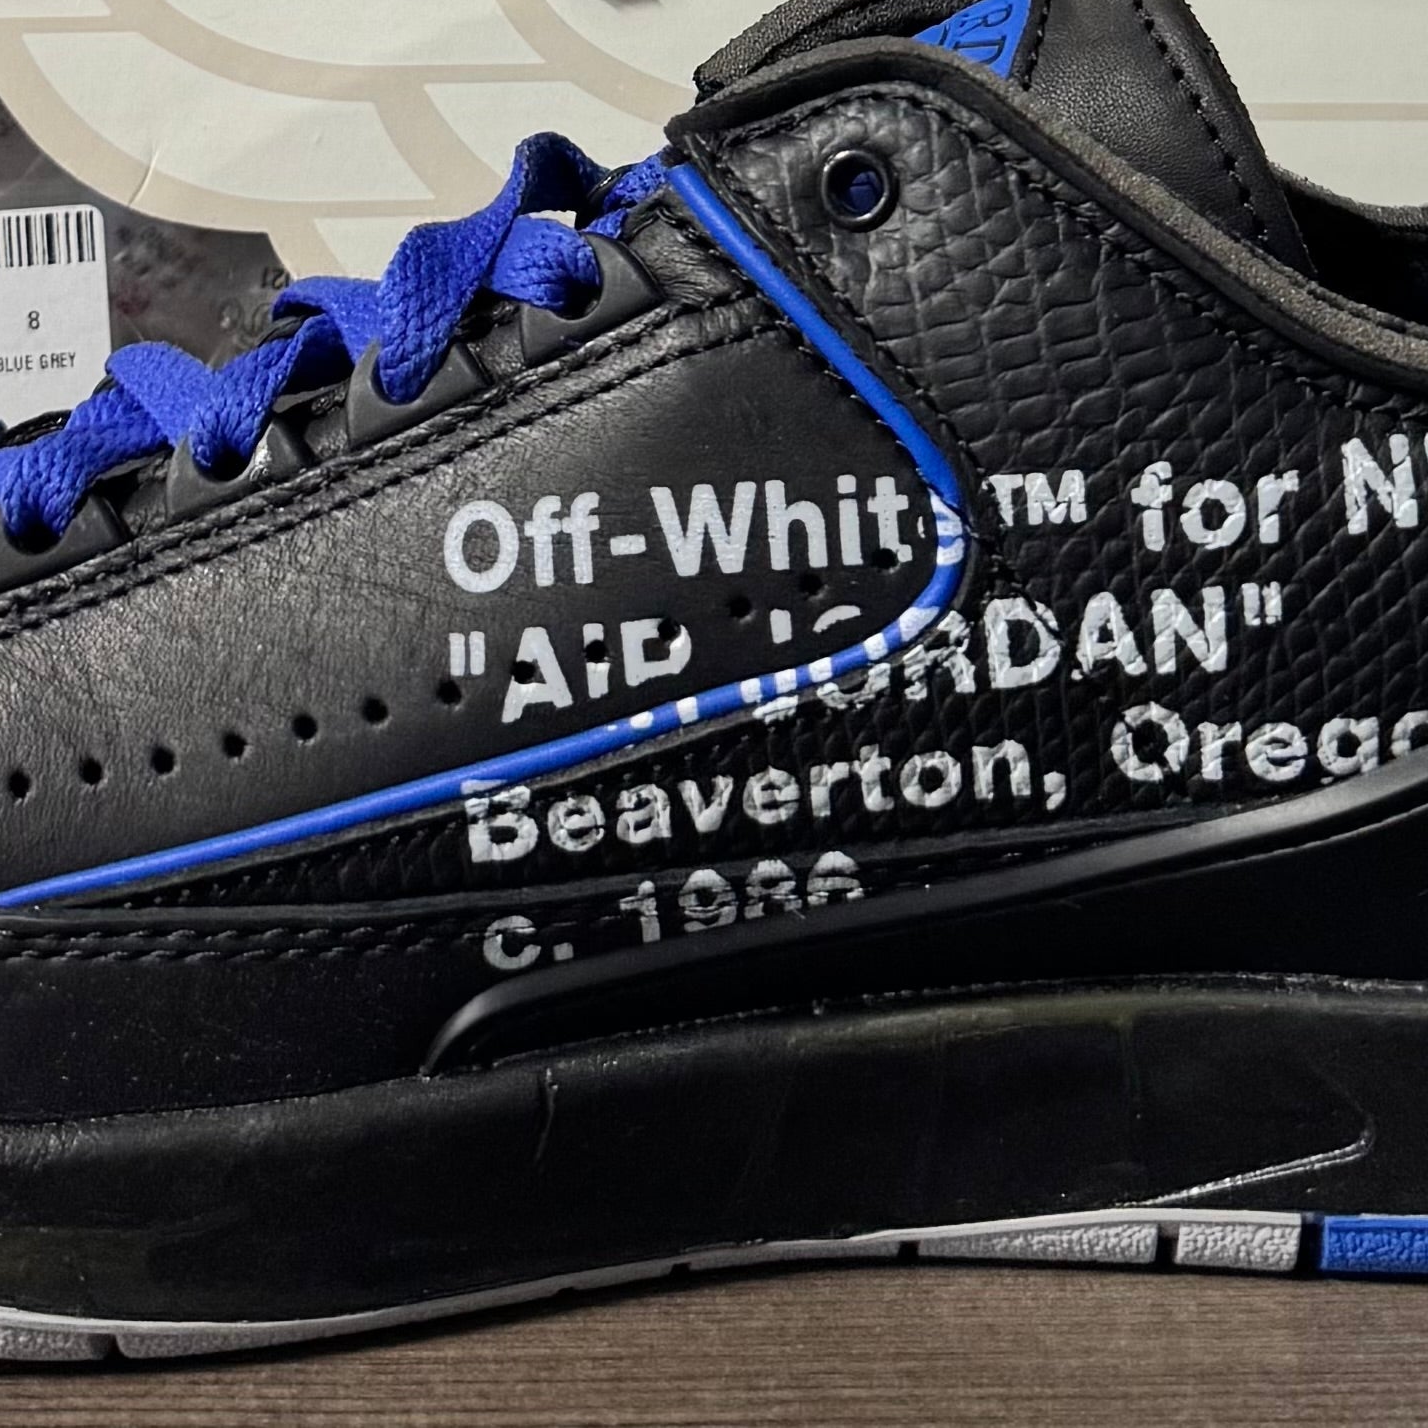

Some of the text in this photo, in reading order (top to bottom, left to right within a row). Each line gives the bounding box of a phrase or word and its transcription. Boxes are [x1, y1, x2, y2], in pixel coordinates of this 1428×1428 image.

[27, 310, 41, 331] 8
[39, 351, 77, 371] GREY
[1130, 460, 1300, 552] for
[462, 740, 1066, 862] Beaverton,
[483, 915, 574, 971] c.
